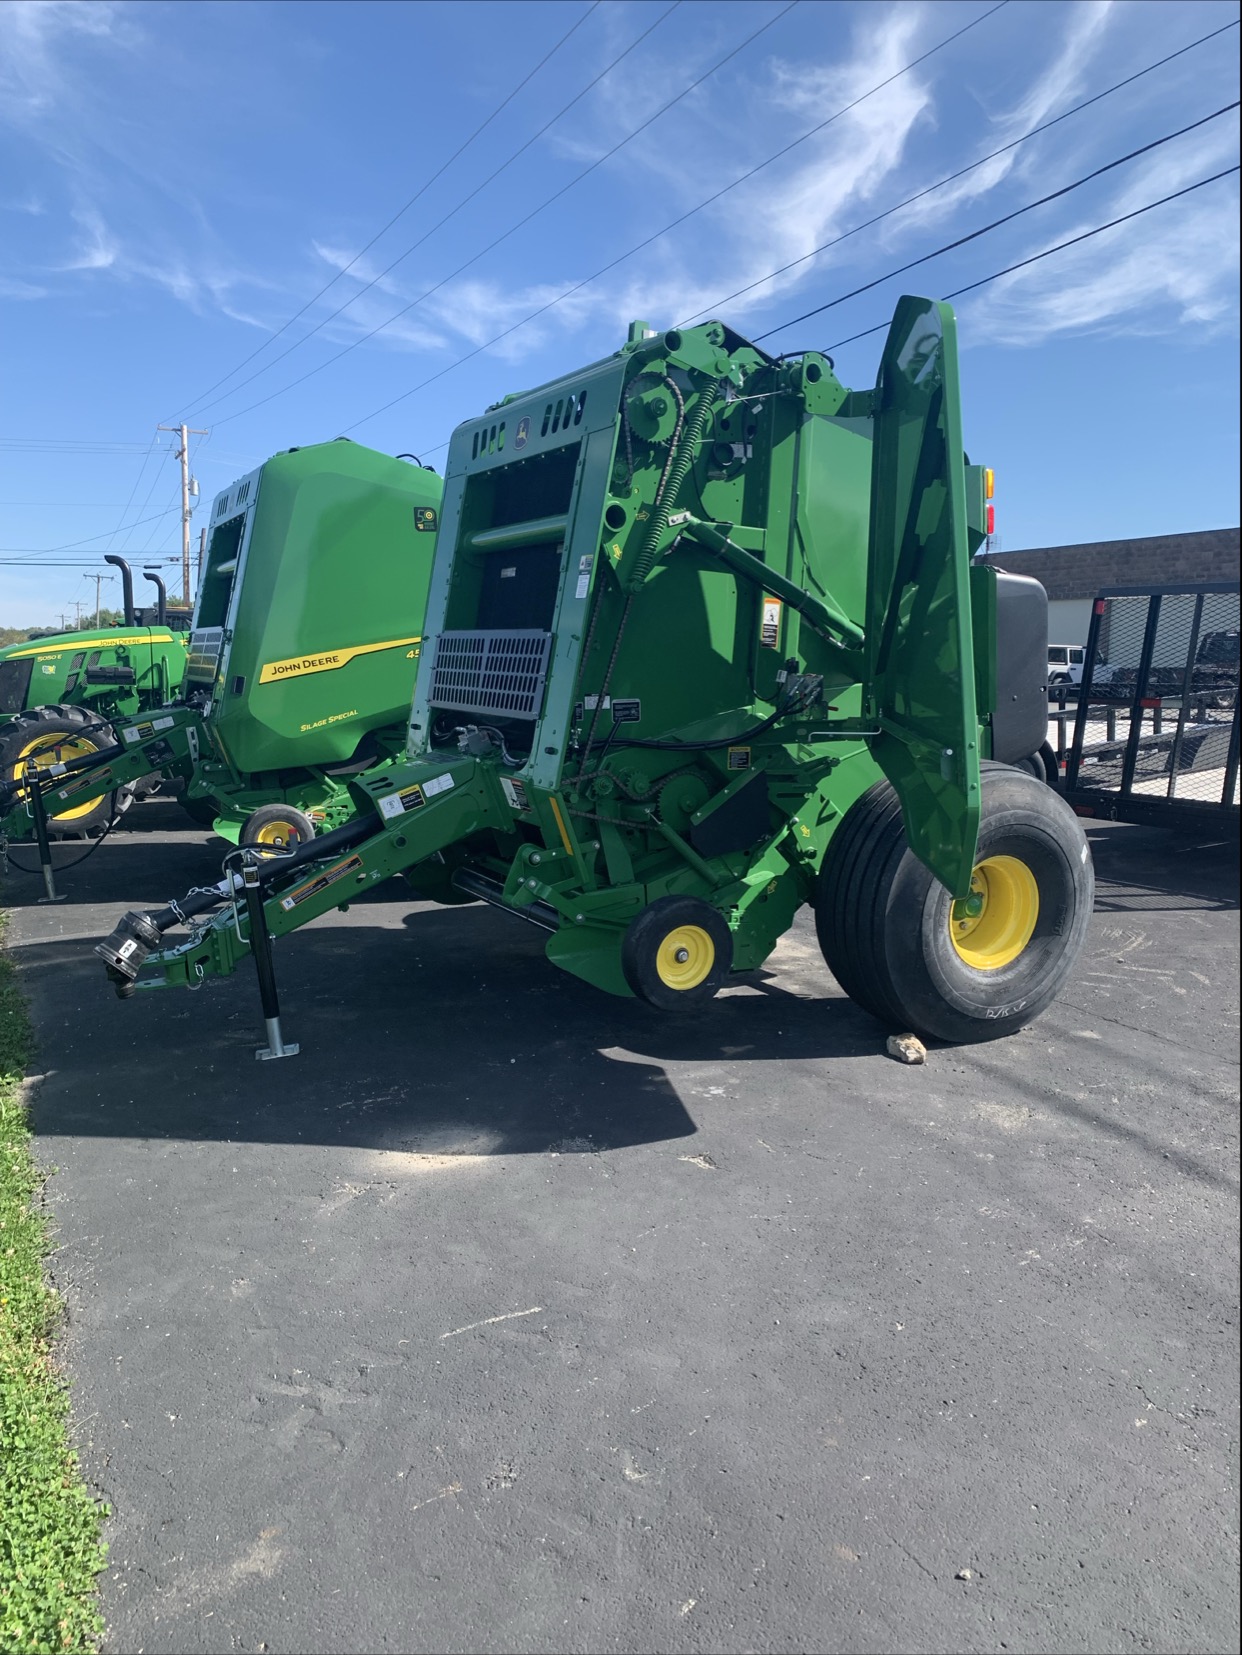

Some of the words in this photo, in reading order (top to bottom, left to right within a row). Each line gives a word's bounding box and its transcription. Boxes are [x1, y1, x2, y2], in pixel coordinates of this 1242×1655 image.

[119, 638, 141, 646] DEERE
[271, 663, 301, 675] JOHN
[302, 655, 340, 669] DEERE
[300, 718, 327, 732] SILAGE
[328, 709, 359, 723] SPECIAL
